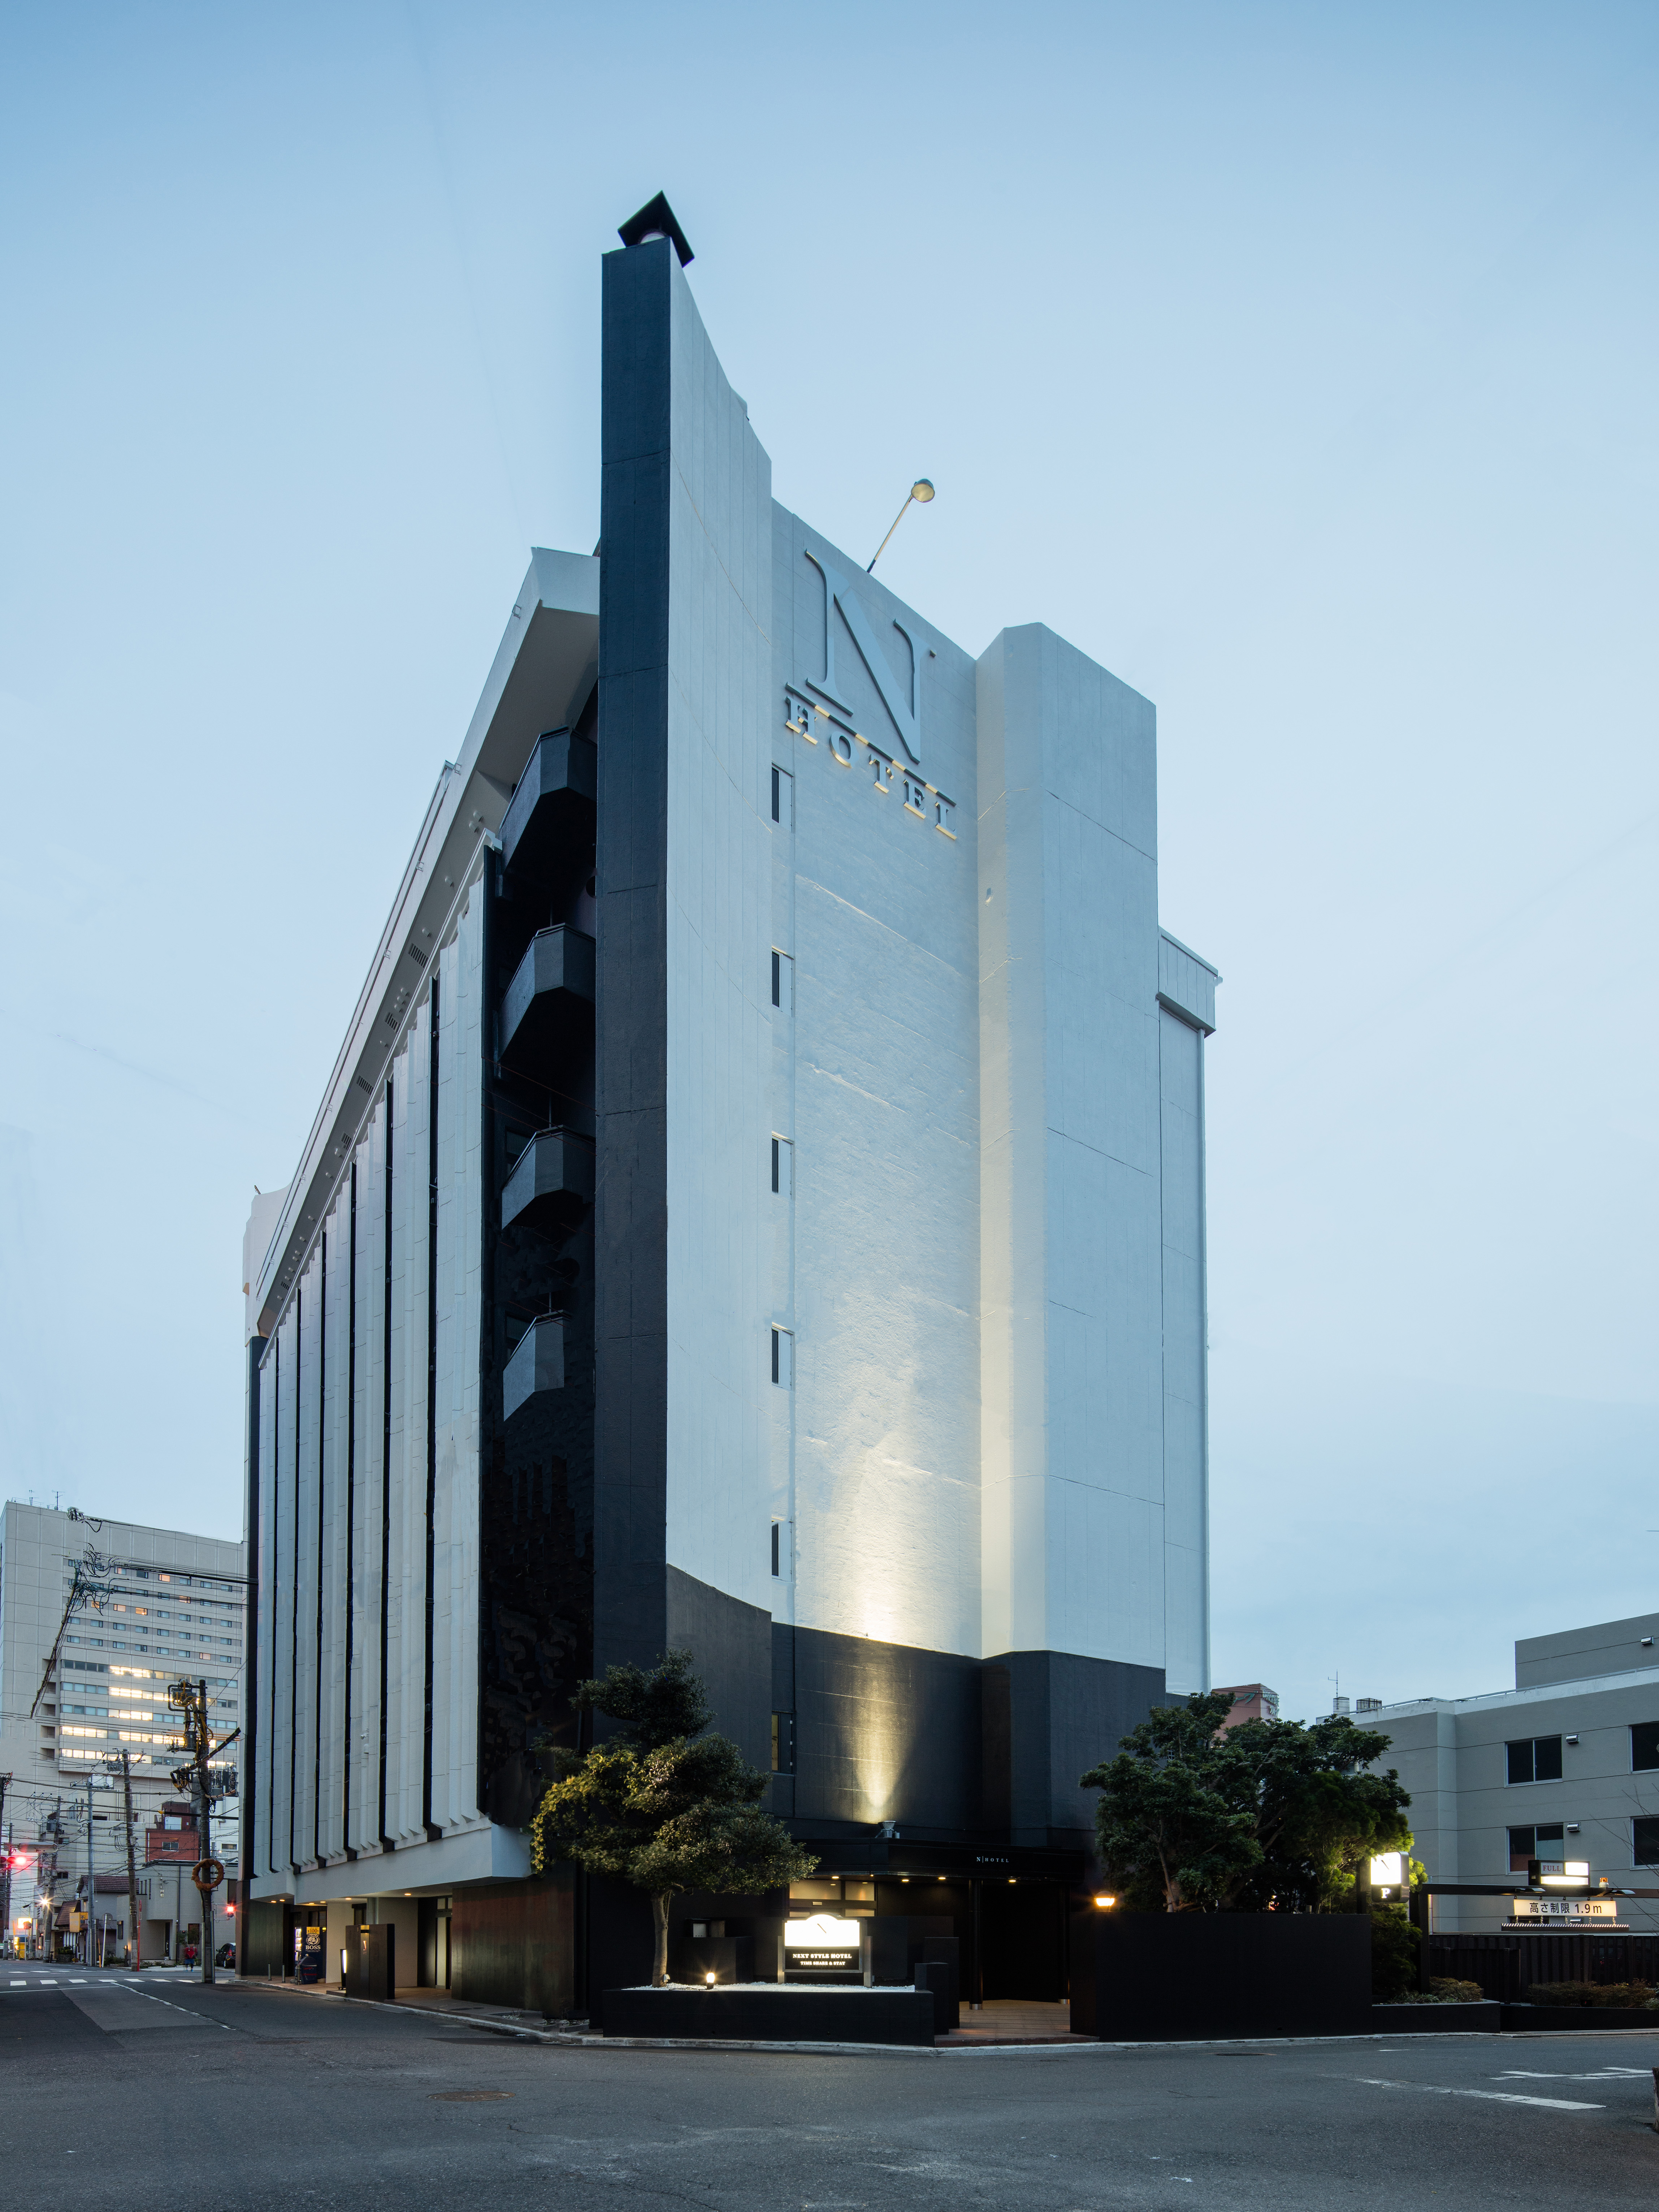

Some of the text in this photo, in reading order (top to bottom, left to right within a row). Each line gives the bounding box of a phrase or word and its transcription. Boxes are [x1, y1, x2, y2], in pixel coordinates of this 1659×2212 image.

[805, 548, 936, 765] N
[785, 695, 957, 841] HOTEL
[1381, 1888, 1390, 1898] P
[1529, 1902, 1570, 1913] 高さ制限
